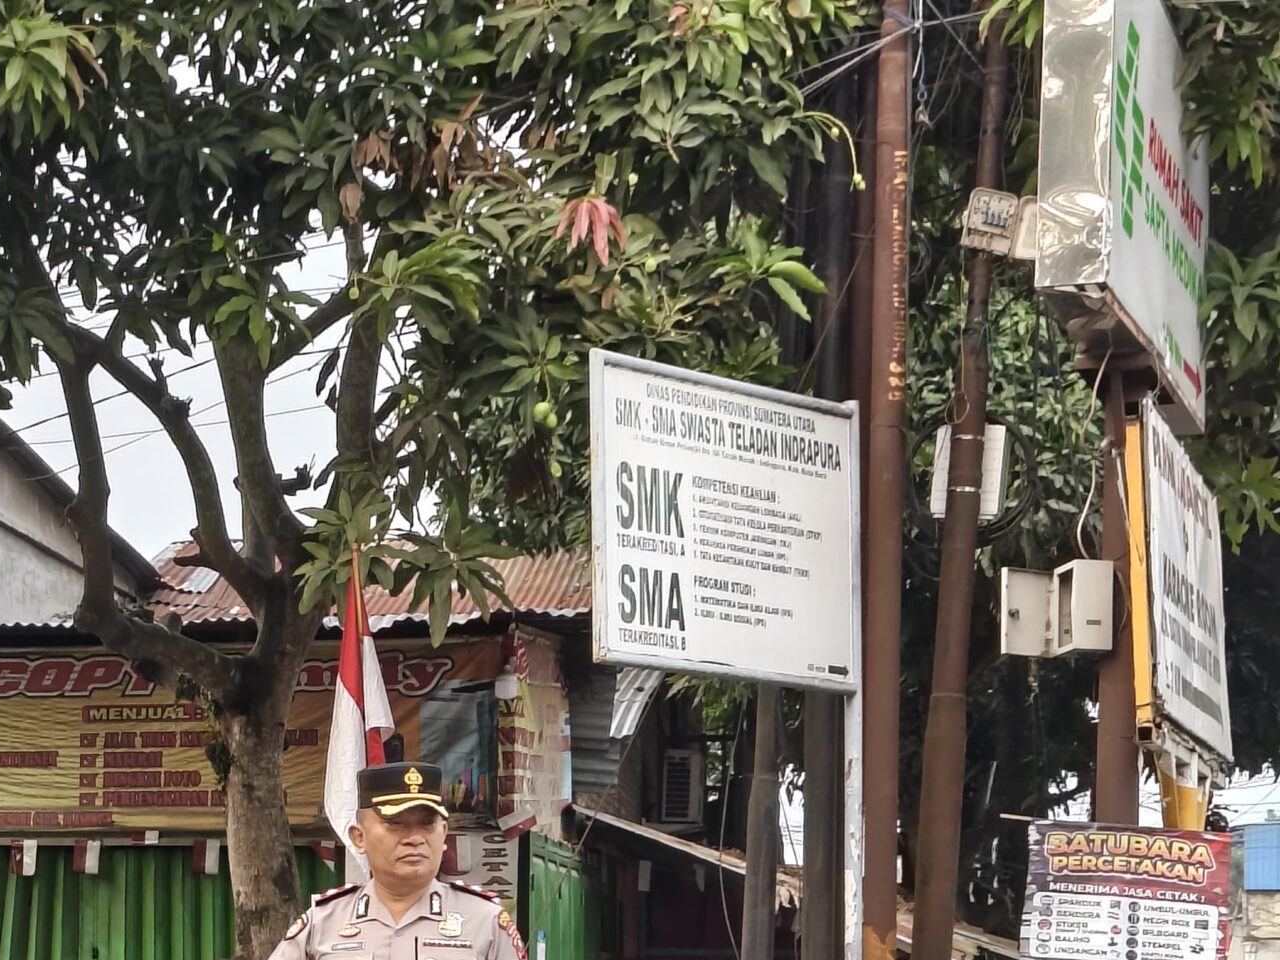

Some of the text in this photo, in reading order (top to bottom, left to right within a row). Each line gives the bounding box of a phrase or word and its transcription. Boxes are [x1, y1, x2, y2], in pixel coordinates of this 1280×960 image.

[1148, 117, 1204, 248] RUMAH SAKIT
[1144, 182, 1171, 262] SAPTA
[646, 382, 670, 402] DINAS
[718, 399, 752, 421] PROVINSI
[753, 406, 792, 430] SUMATERA
[793, 415, 816, 435] UTARA
[615, 397, 642, 431] SMK
[652, 404, 677, 438] SMA
[680, 411, 726, 448] SWASTA
[728, 421, 778, 459] TELADAN
[781, 432, 842, 472] INDRAPURA
[616, 461, 685, 538] SMK
[692, 475, 738, 496] KOMPETENSI
[680, 543, 686, 556] A
[618, 564, 686, 632] SMA
[694, 575, 729, 592] PROGRAM
[731, 582, 752, 597] STUDI
[681, 636, 686, 651] B
[89, 707, 191, 721] MENJUAL
[1047, 832, 1214, 869] BATUBARA
[1051, 855, 1205, 884] PERCETAKAN
[1049, 881, 1197, 902] MENERIMA JASA CETAK
